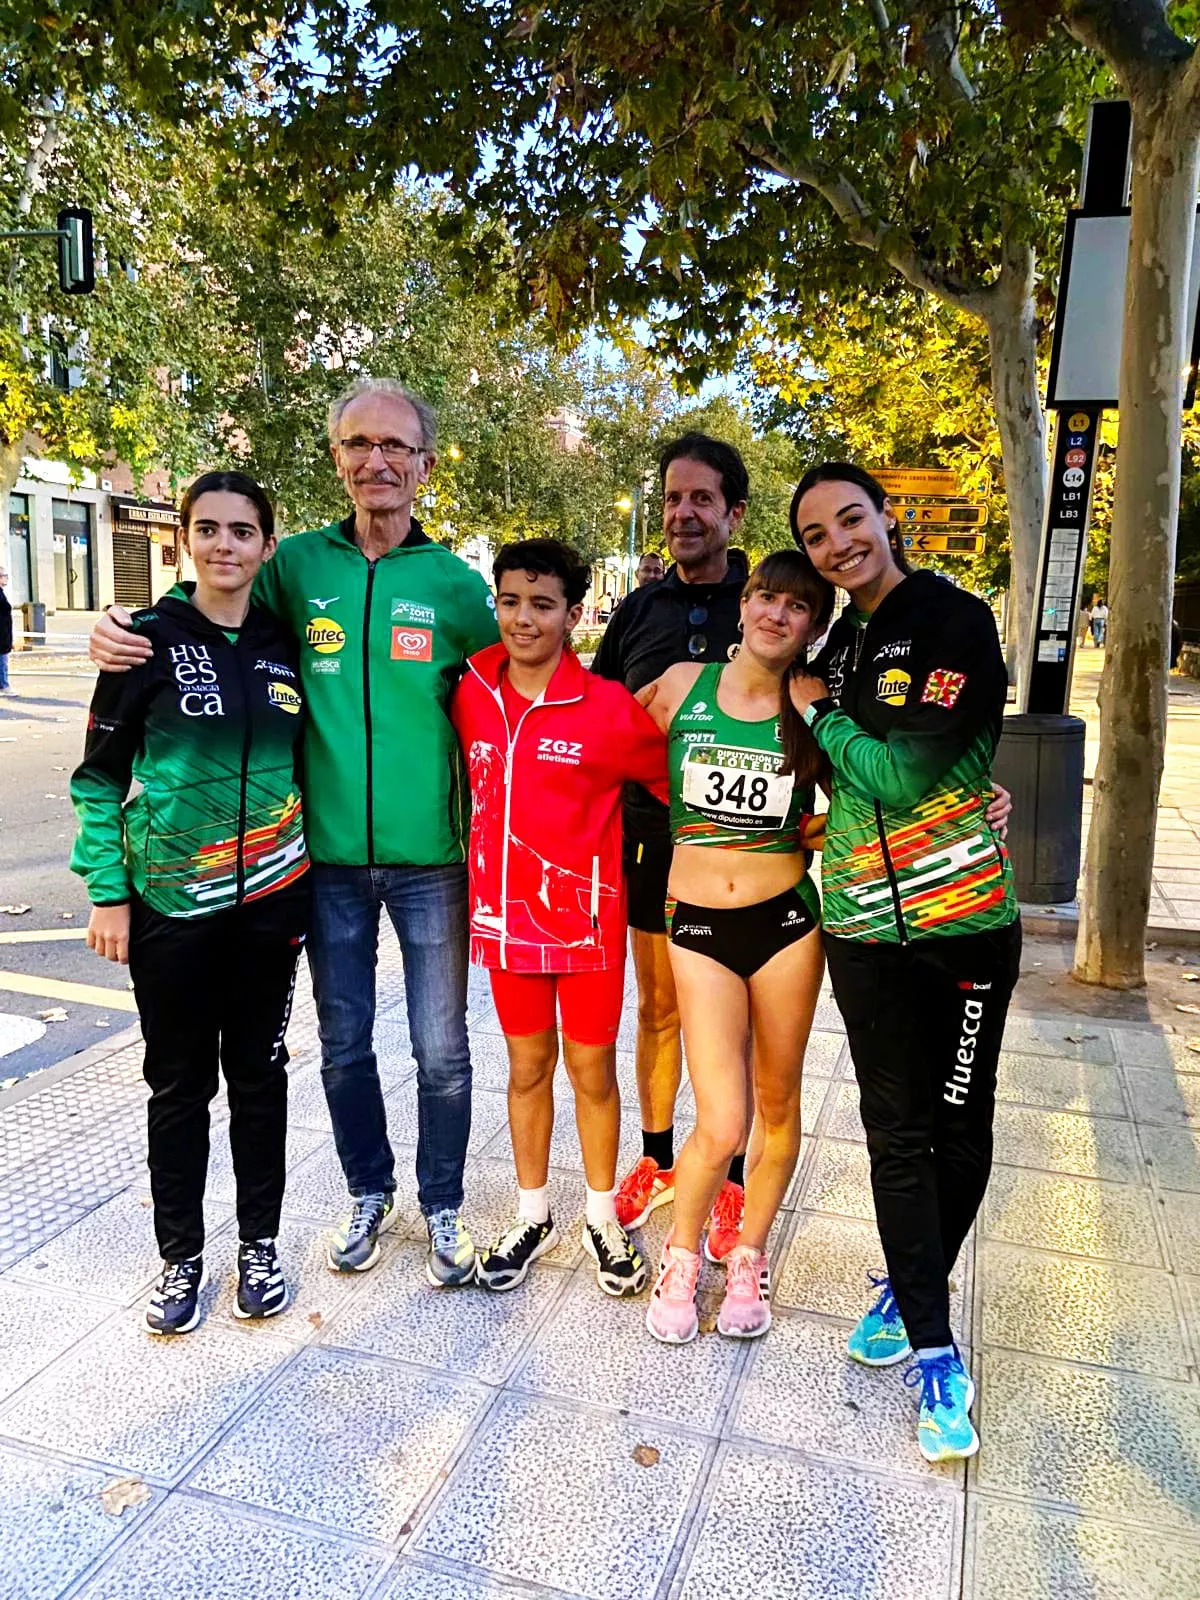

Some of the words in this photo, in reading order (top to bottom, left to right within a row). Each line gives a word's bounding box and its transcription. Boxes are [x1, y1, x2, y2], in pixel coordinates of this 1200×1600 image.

[1073, 418, 1085, 427] L1
[1070, 437, 1083, 446] L2
[1067, 455, 1085, 463] L92
[1065, 473, 1082, 482] L14
[1063, 492, 1081, 500] LB1
[1060, 510, 1079, 519] LB3
[168, 644, 211, 662] Hu
[175, 661, 217, 685] es
[180, 692, 226, 717] ca
[680, 713, 714, 721] VIATOR
[682, 733, 716, 743] ZOITI
[537, 737, 583, 757] ZGZ
[536, 753, 580, 766] atletismo
[717, 749, 772, 764] DIPUTACIÓN
[705, 771, 769, 812] 348
[701, 811, 763, 825] www.diputoledo.es
[781, 917, 806, 928] VIATOR
[943, 999, 983, 1105] Huesca
